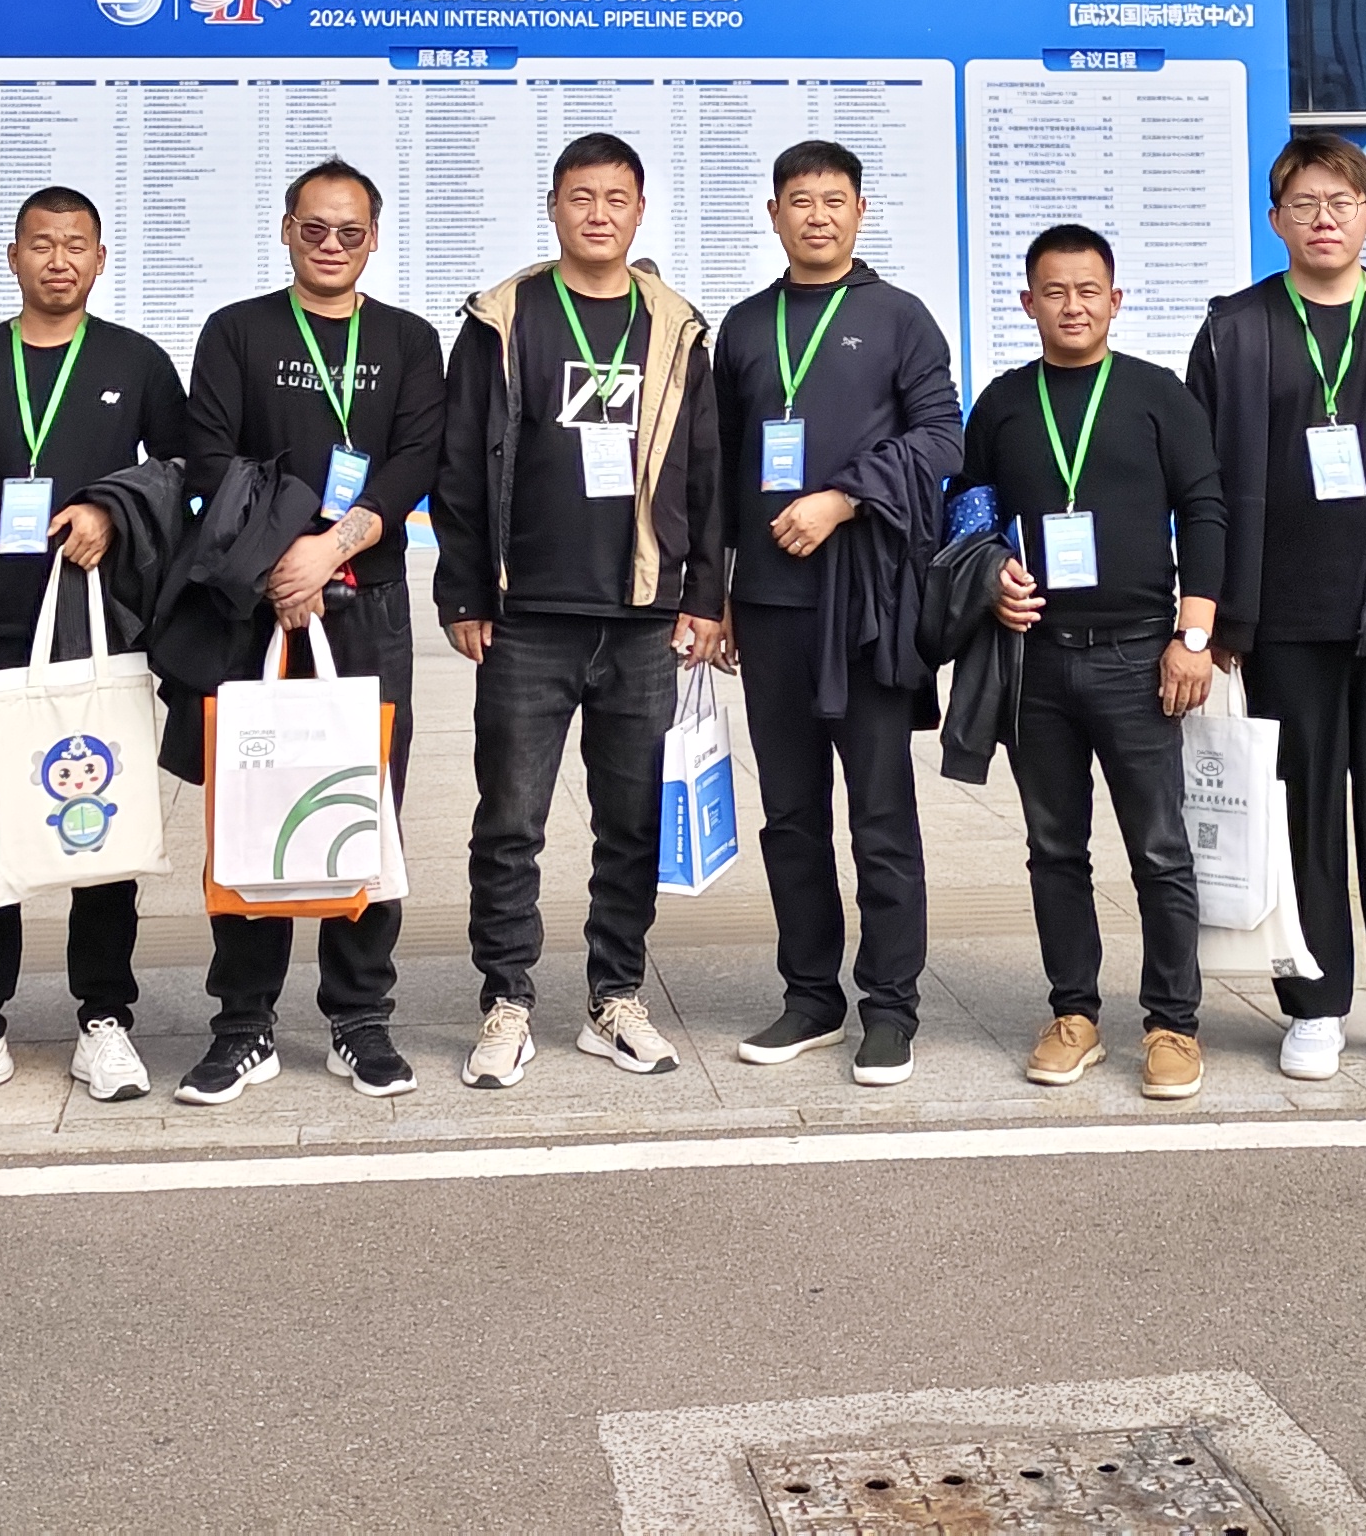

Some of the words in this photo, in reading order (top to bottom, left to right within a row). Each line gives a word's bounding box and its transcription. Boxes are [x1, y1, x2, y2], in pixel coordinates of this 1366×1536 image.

[310, 10, 356, 27] 2024
[360, 10, 440, 27] WUHAN
[444, 10, 599, 28] INTERNATIONAL
[603, 10, 688, 28] PIPELINE
[692, 10, 743, 28] EXPO
[417, 48, 489, 68] 展商名录
[1069, 51, 1138, 70] 会议日程
